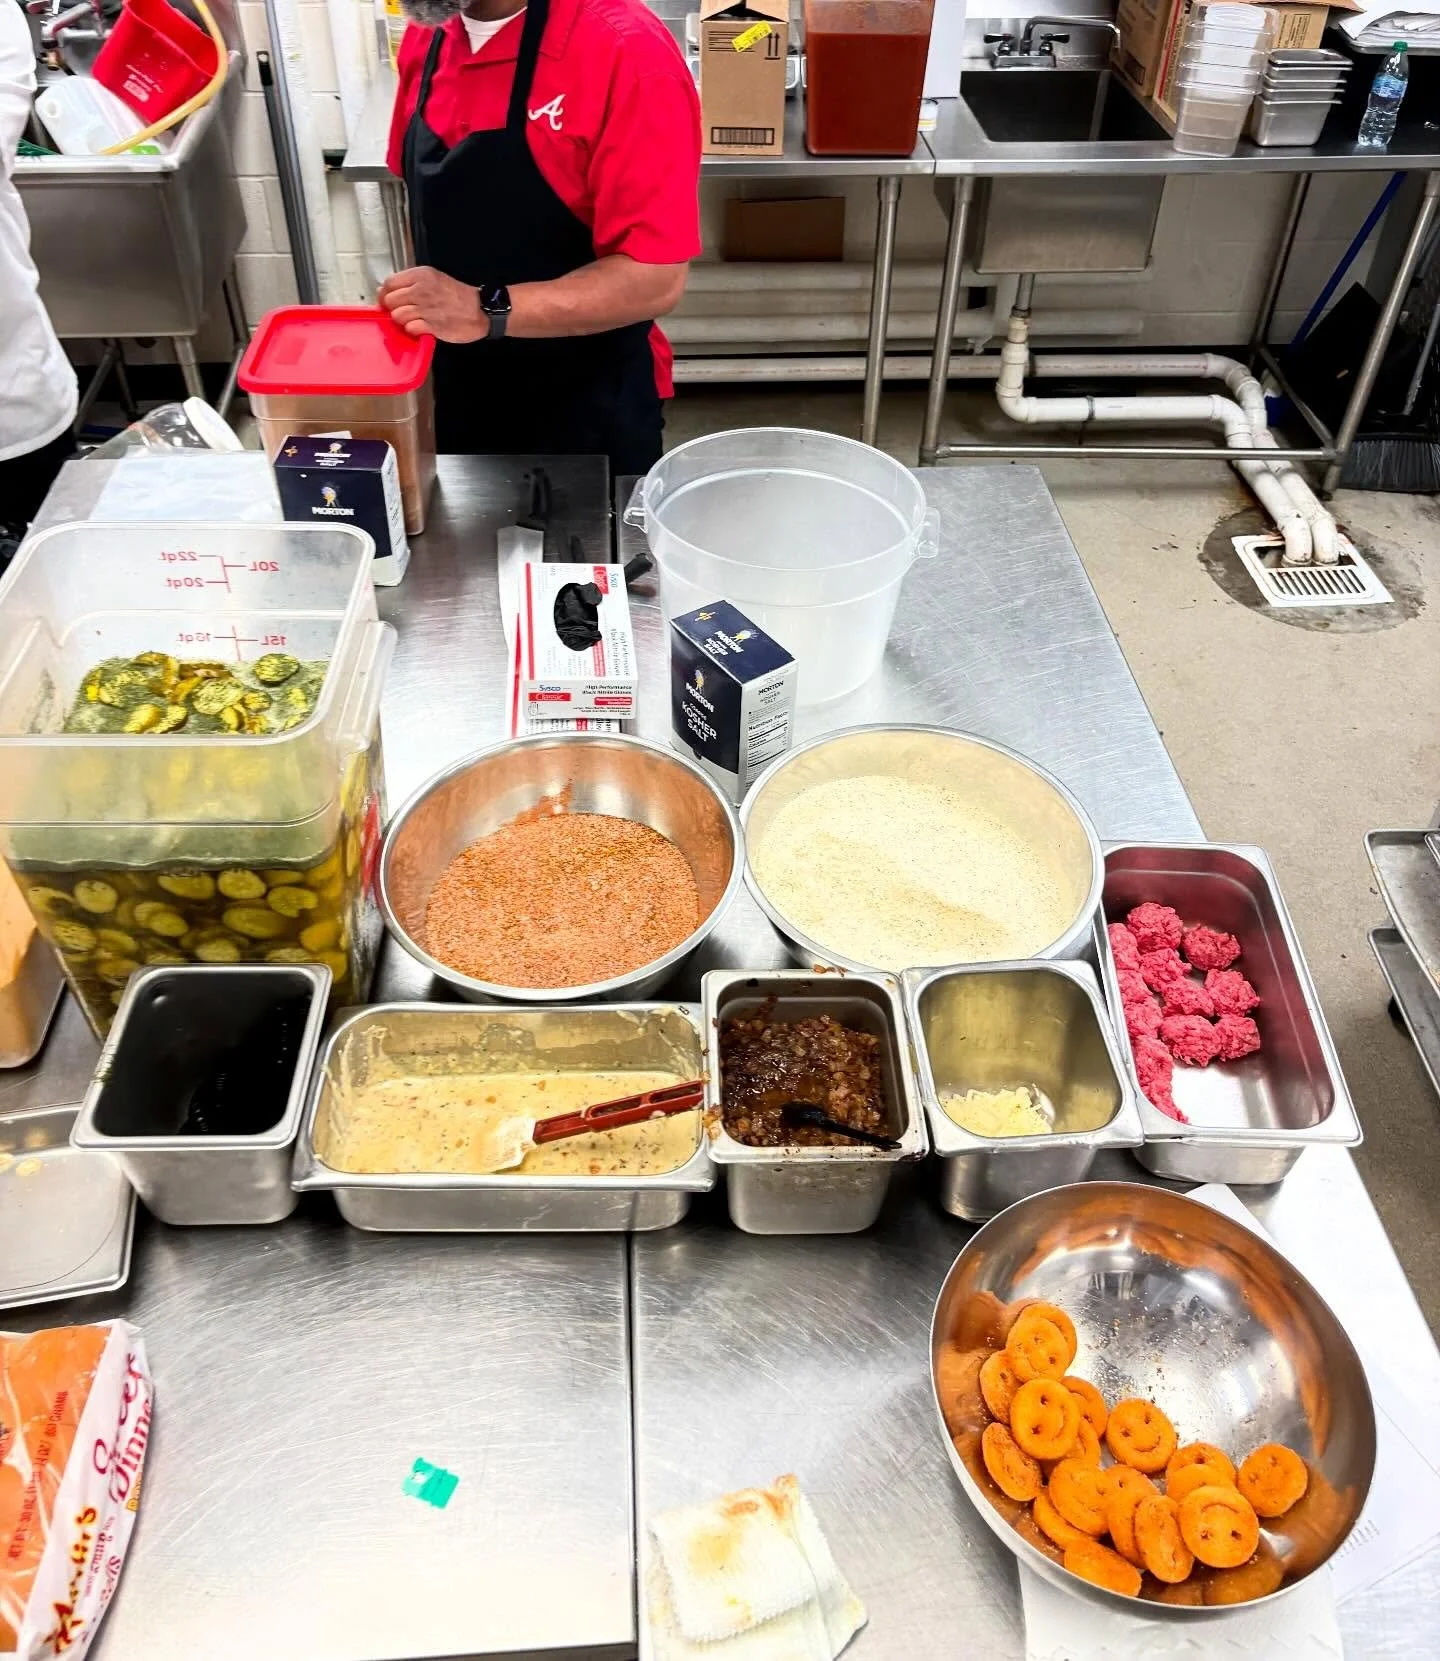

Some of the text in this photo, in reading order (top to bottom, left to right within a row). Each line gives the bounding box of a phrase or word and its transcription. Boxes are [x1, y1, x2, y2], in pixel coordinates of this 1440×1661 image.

[528, 94, 566, 130] A
[312, 506, 354, 515] MORTON
[714, 631, 744, 653] MORTON
[686, 682, 714, 713] MORTON
[758, 680, 784, 696] MORTON
[682, 701, 717, 739] KOSHER
[687, 718, 709, 742] SALT
